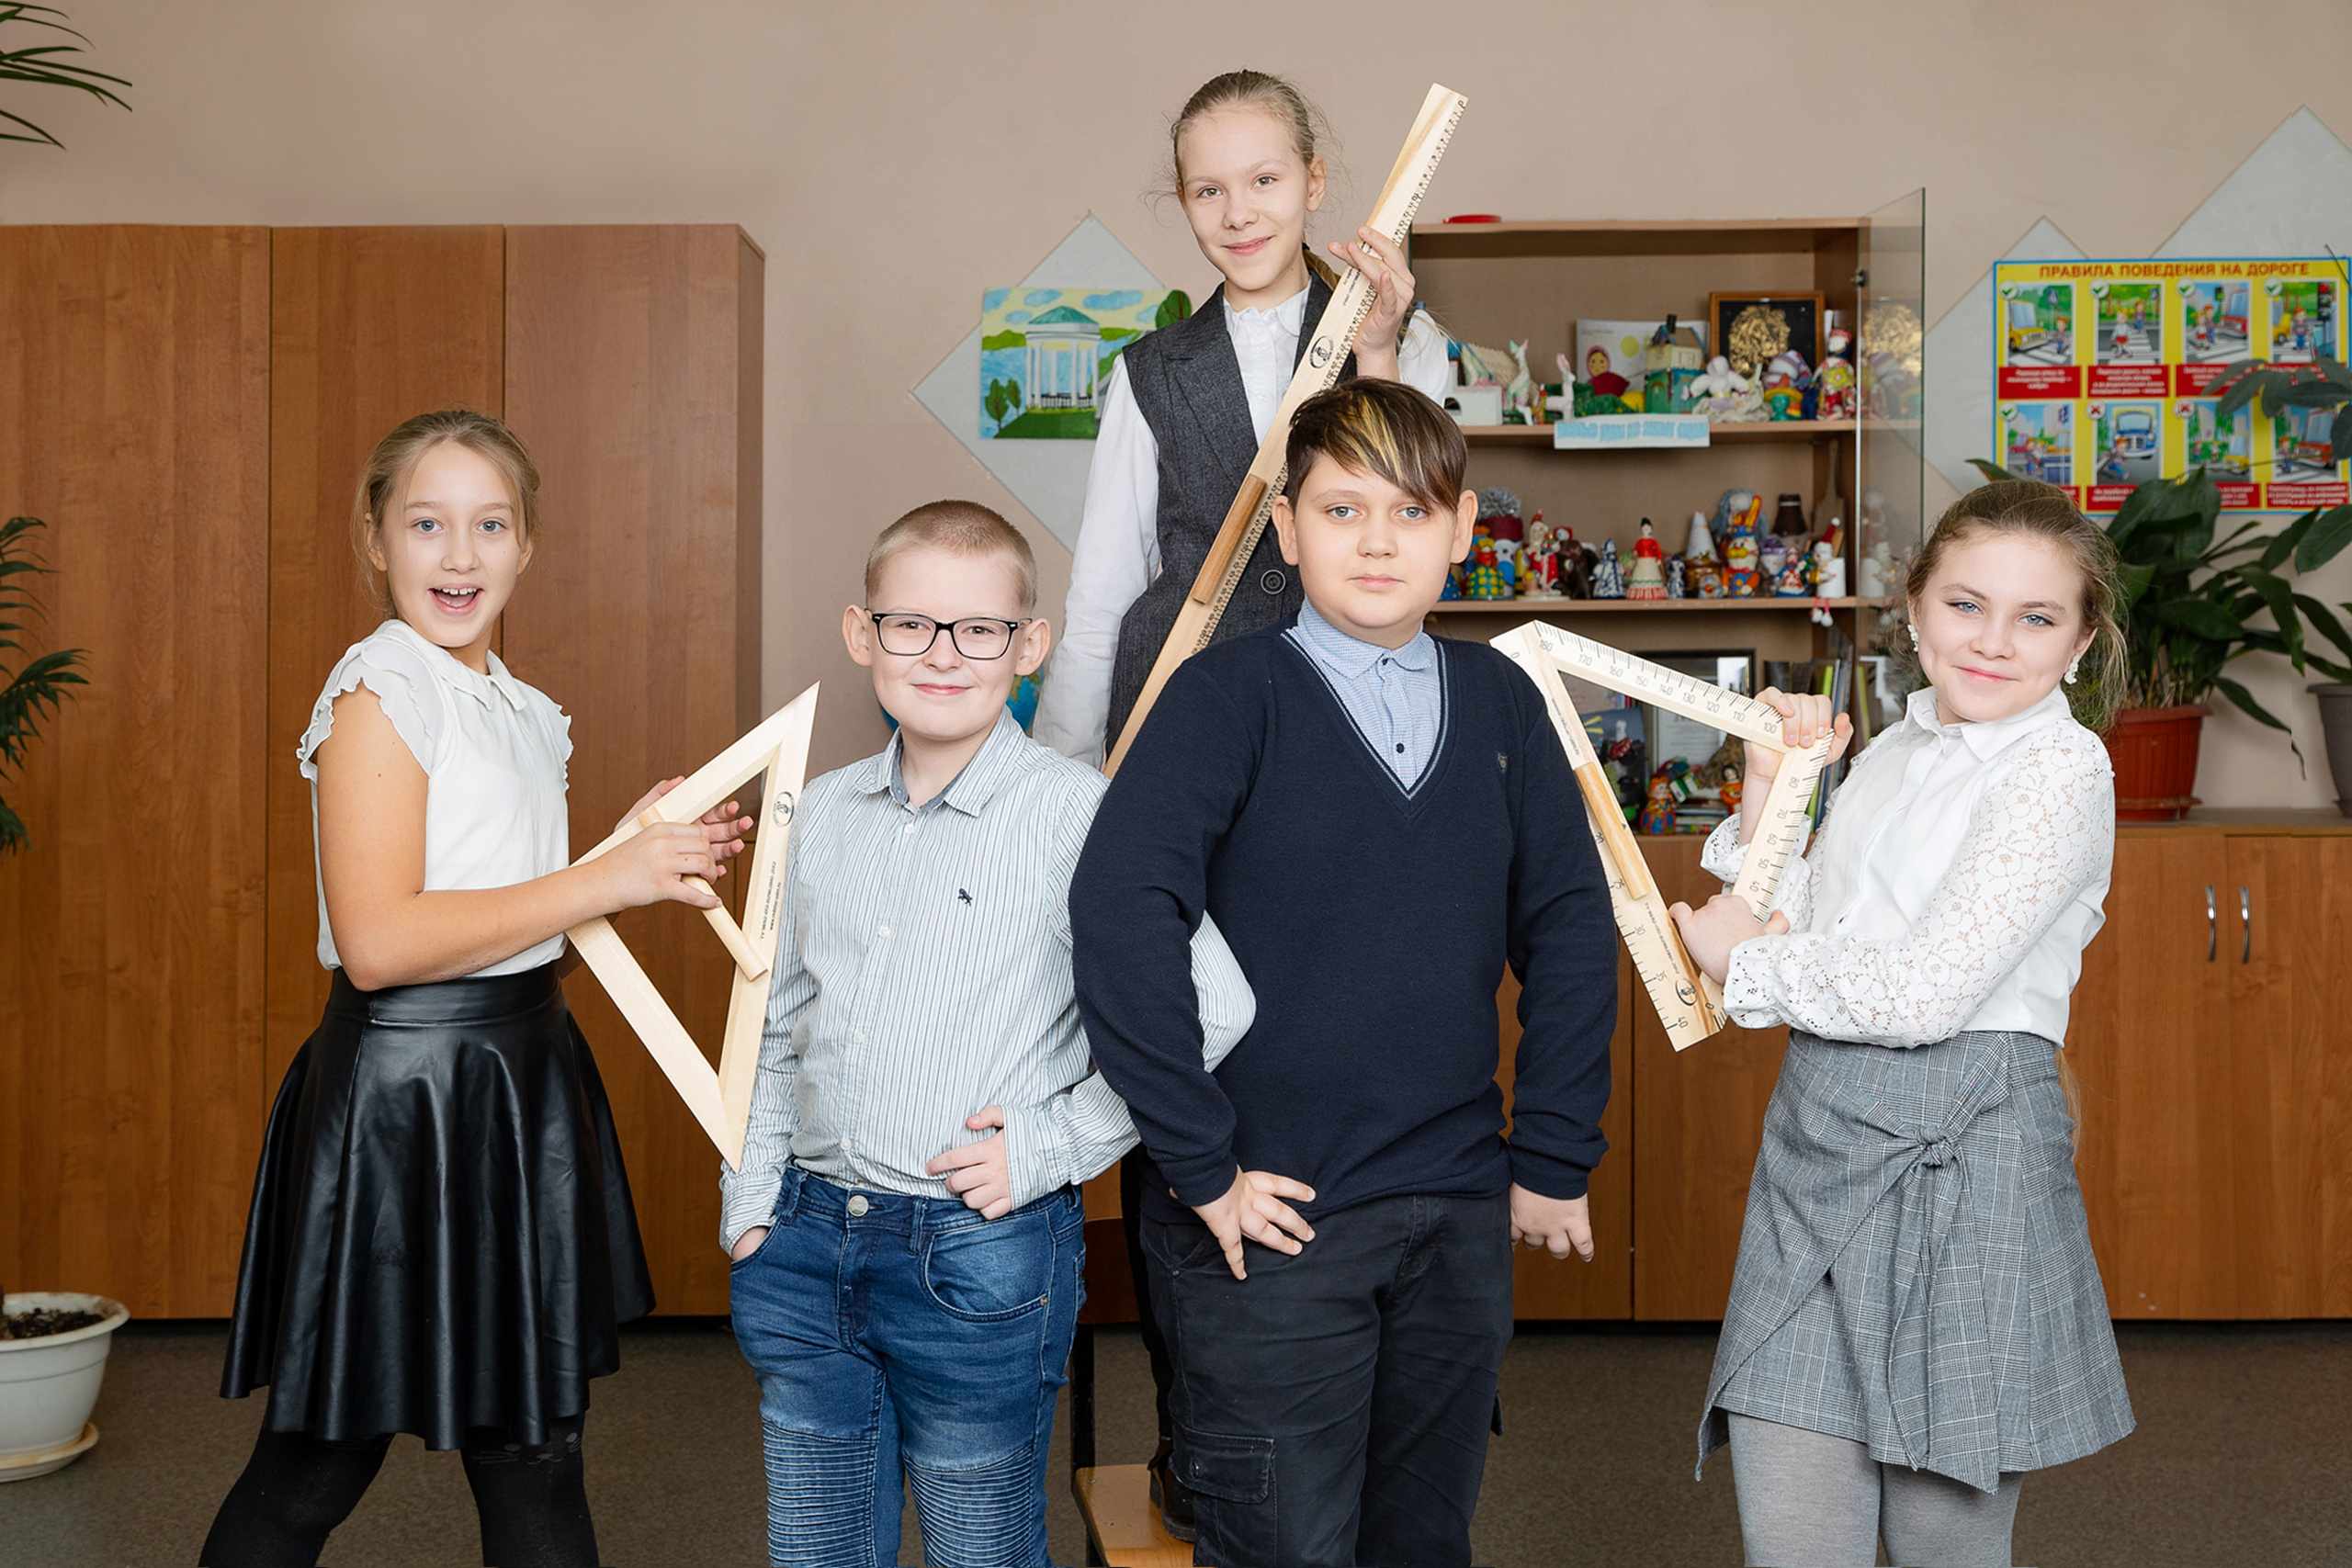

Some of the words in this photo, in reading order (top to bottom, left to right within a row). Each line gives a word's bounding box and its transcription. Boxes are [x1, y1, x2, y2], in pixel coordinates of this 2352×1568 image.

[2040, 265, 2115, 277] ПРАВИЛА
[2120, 263, 2215, 278] ПОВЕДЕНИЯ
[2221, 263, 2243, 276] НА
[2246, 262, 2311, 277] ДОРОГЕ
[1539, 639, 1554, 652] 180
[1578, 654, 1593, 667] 170
[1610, 665, 1623, 678] 160
[1635, 675, 1649, 687] 150
[1659, 683, 1673, 696] 140
[1682, 692, 1696, 705] 130
[1706, 701, 1720, 714] 120
[1733, 710, 1747, 723] 110
[1763, 721, 1778, 735] 100
[1788, 776, 1800, 789] 80
[1776, 808, 1789, 820] 70
[1766, 832, 1779, 846] 60
[1758, 858, 1770, 870] 50
[1749, 880, 1760, 893] 40
[1613, 878, 1626, 890] 25
[1634, 924, 1646, 936] 30
[1656, 970, 1668, 982] 35
[1677, 1016, 1690, 1029] 40
[1705, 1002, 1714, 1010] 0
